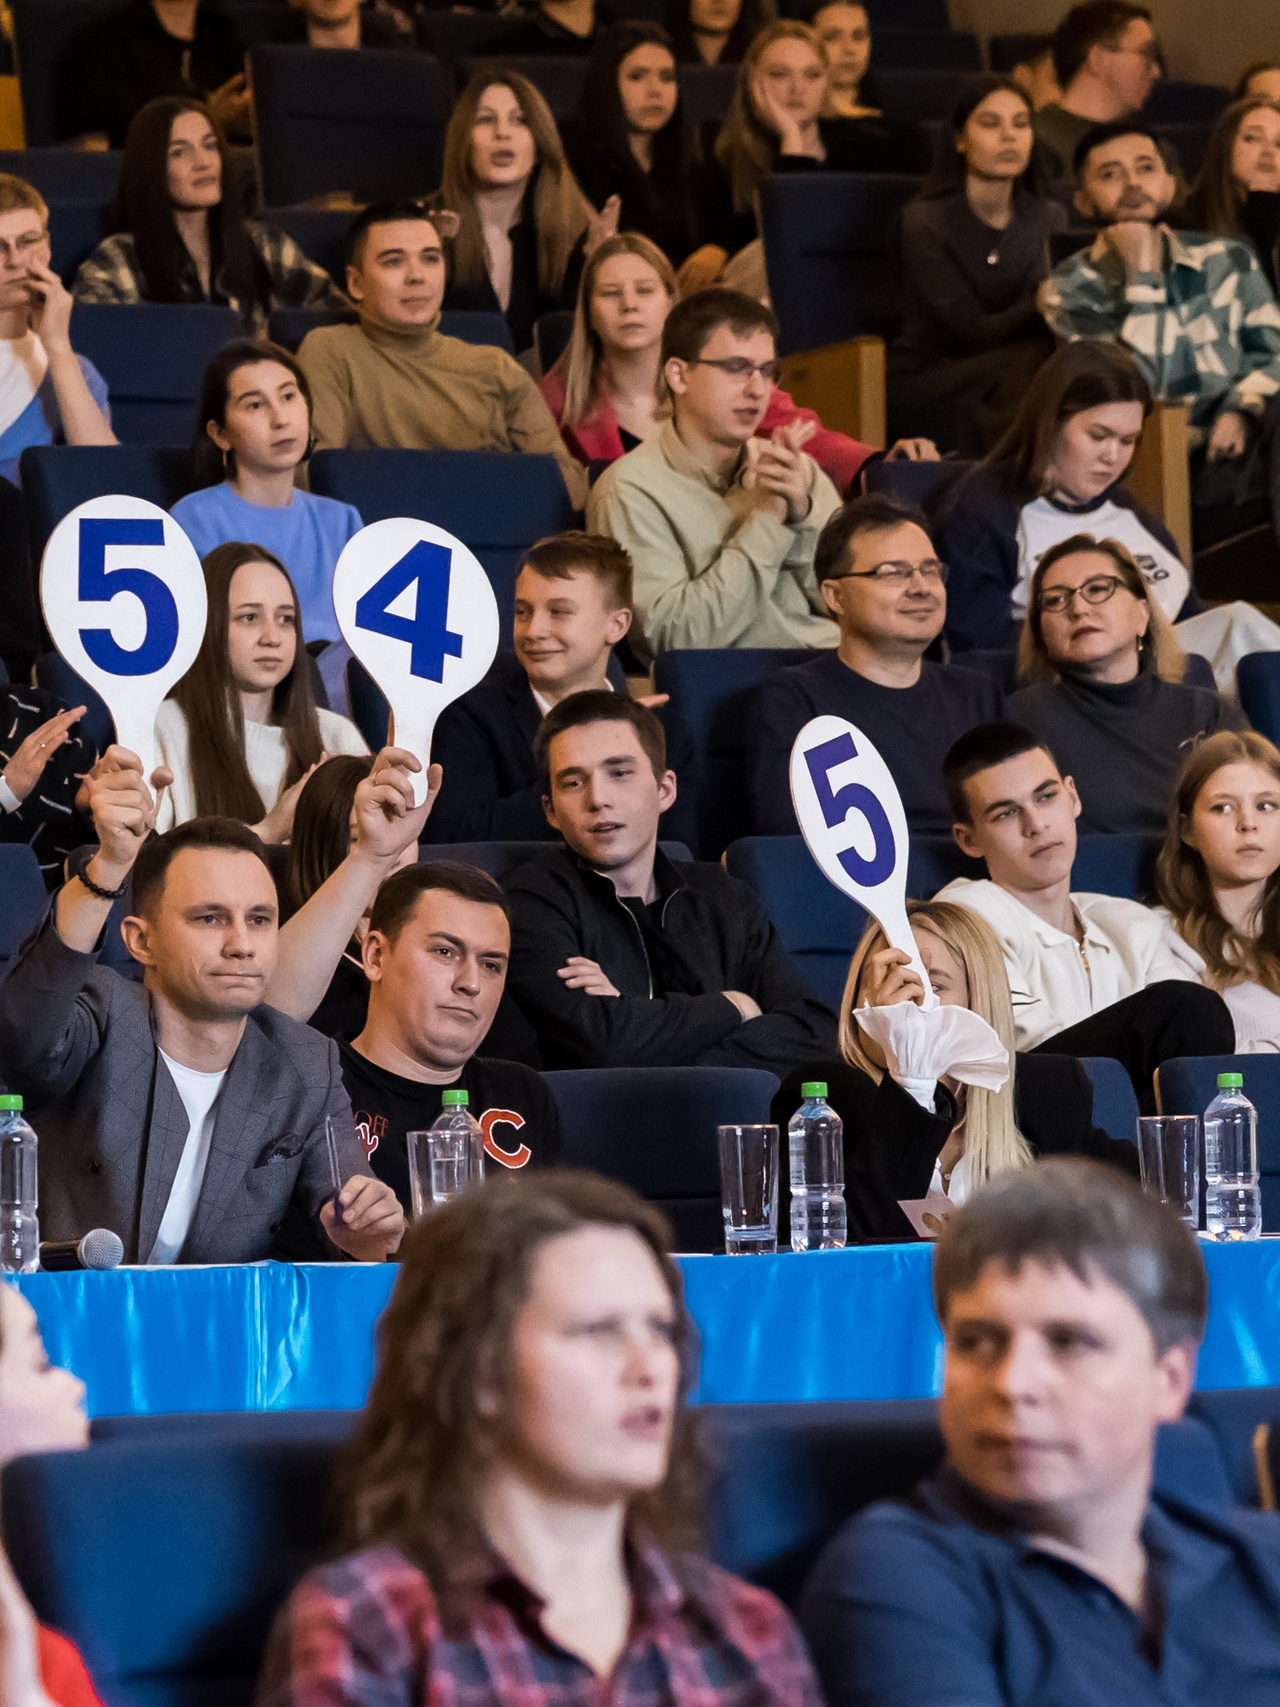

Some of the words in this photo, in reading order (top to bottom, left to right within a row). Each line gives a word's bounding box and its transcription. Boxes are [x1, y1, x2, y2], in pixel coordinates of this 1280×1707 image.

[78, 518, 179, 676] 5
[355, 540, 464, 684] 4
[803, 732, 896, 887] 5
[480, 1108, 532, 1169] C
